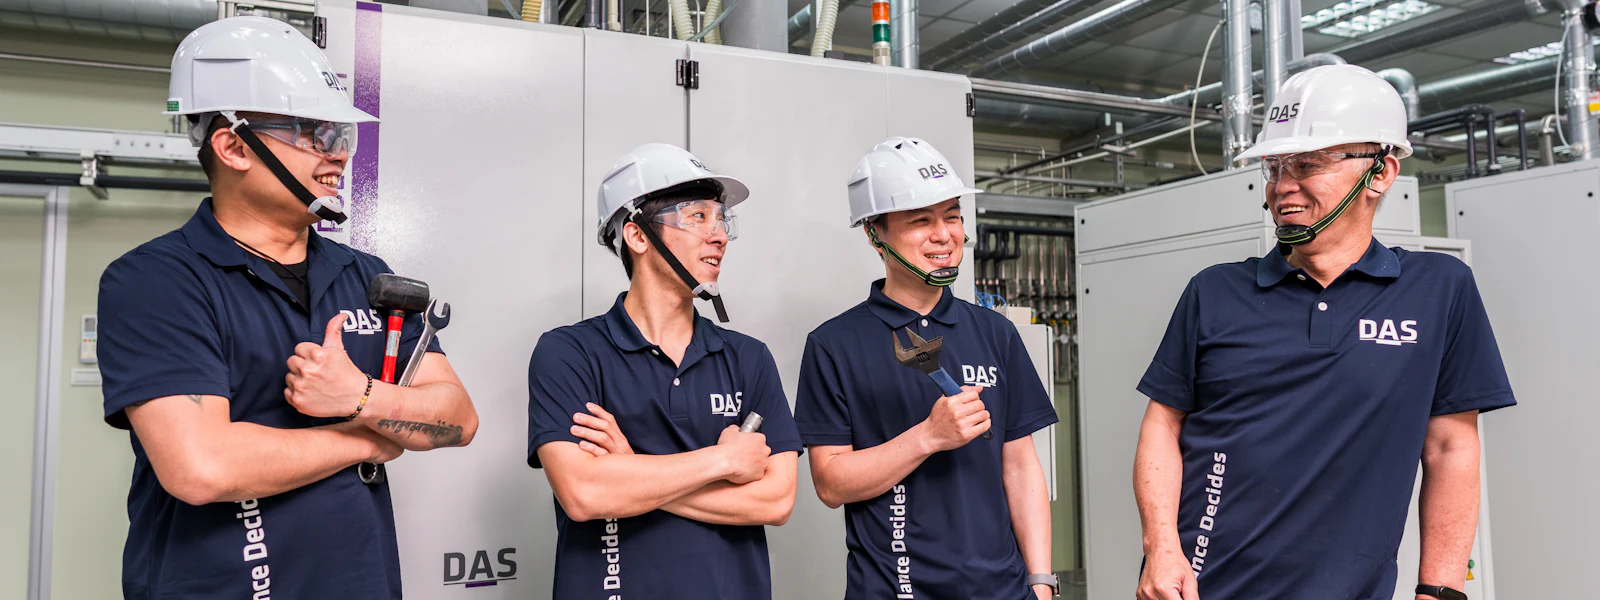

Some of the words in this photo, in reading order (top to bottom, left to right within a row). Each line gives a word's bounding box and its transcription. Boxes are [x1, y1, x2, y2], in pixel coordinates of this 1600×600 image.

[1269, 102, 1300, 121] DAS
[918, 163, 948, 179] DAS
[339, 308, 382, 331] DAS
[1359, 318, 1418, 342] DAS
[961, 364, 998, 385] DAS
[709, 391, 743, 413] DAS
[1199, 451, 1226, 531] Decides
[234, 498, 268, 562] Decid
[889, 484, 906, 552] Decides
[443, 547, 517, 583] DAS
[1191, 534, 1209, 578] nce
[251, 564, 271, 600] nce
